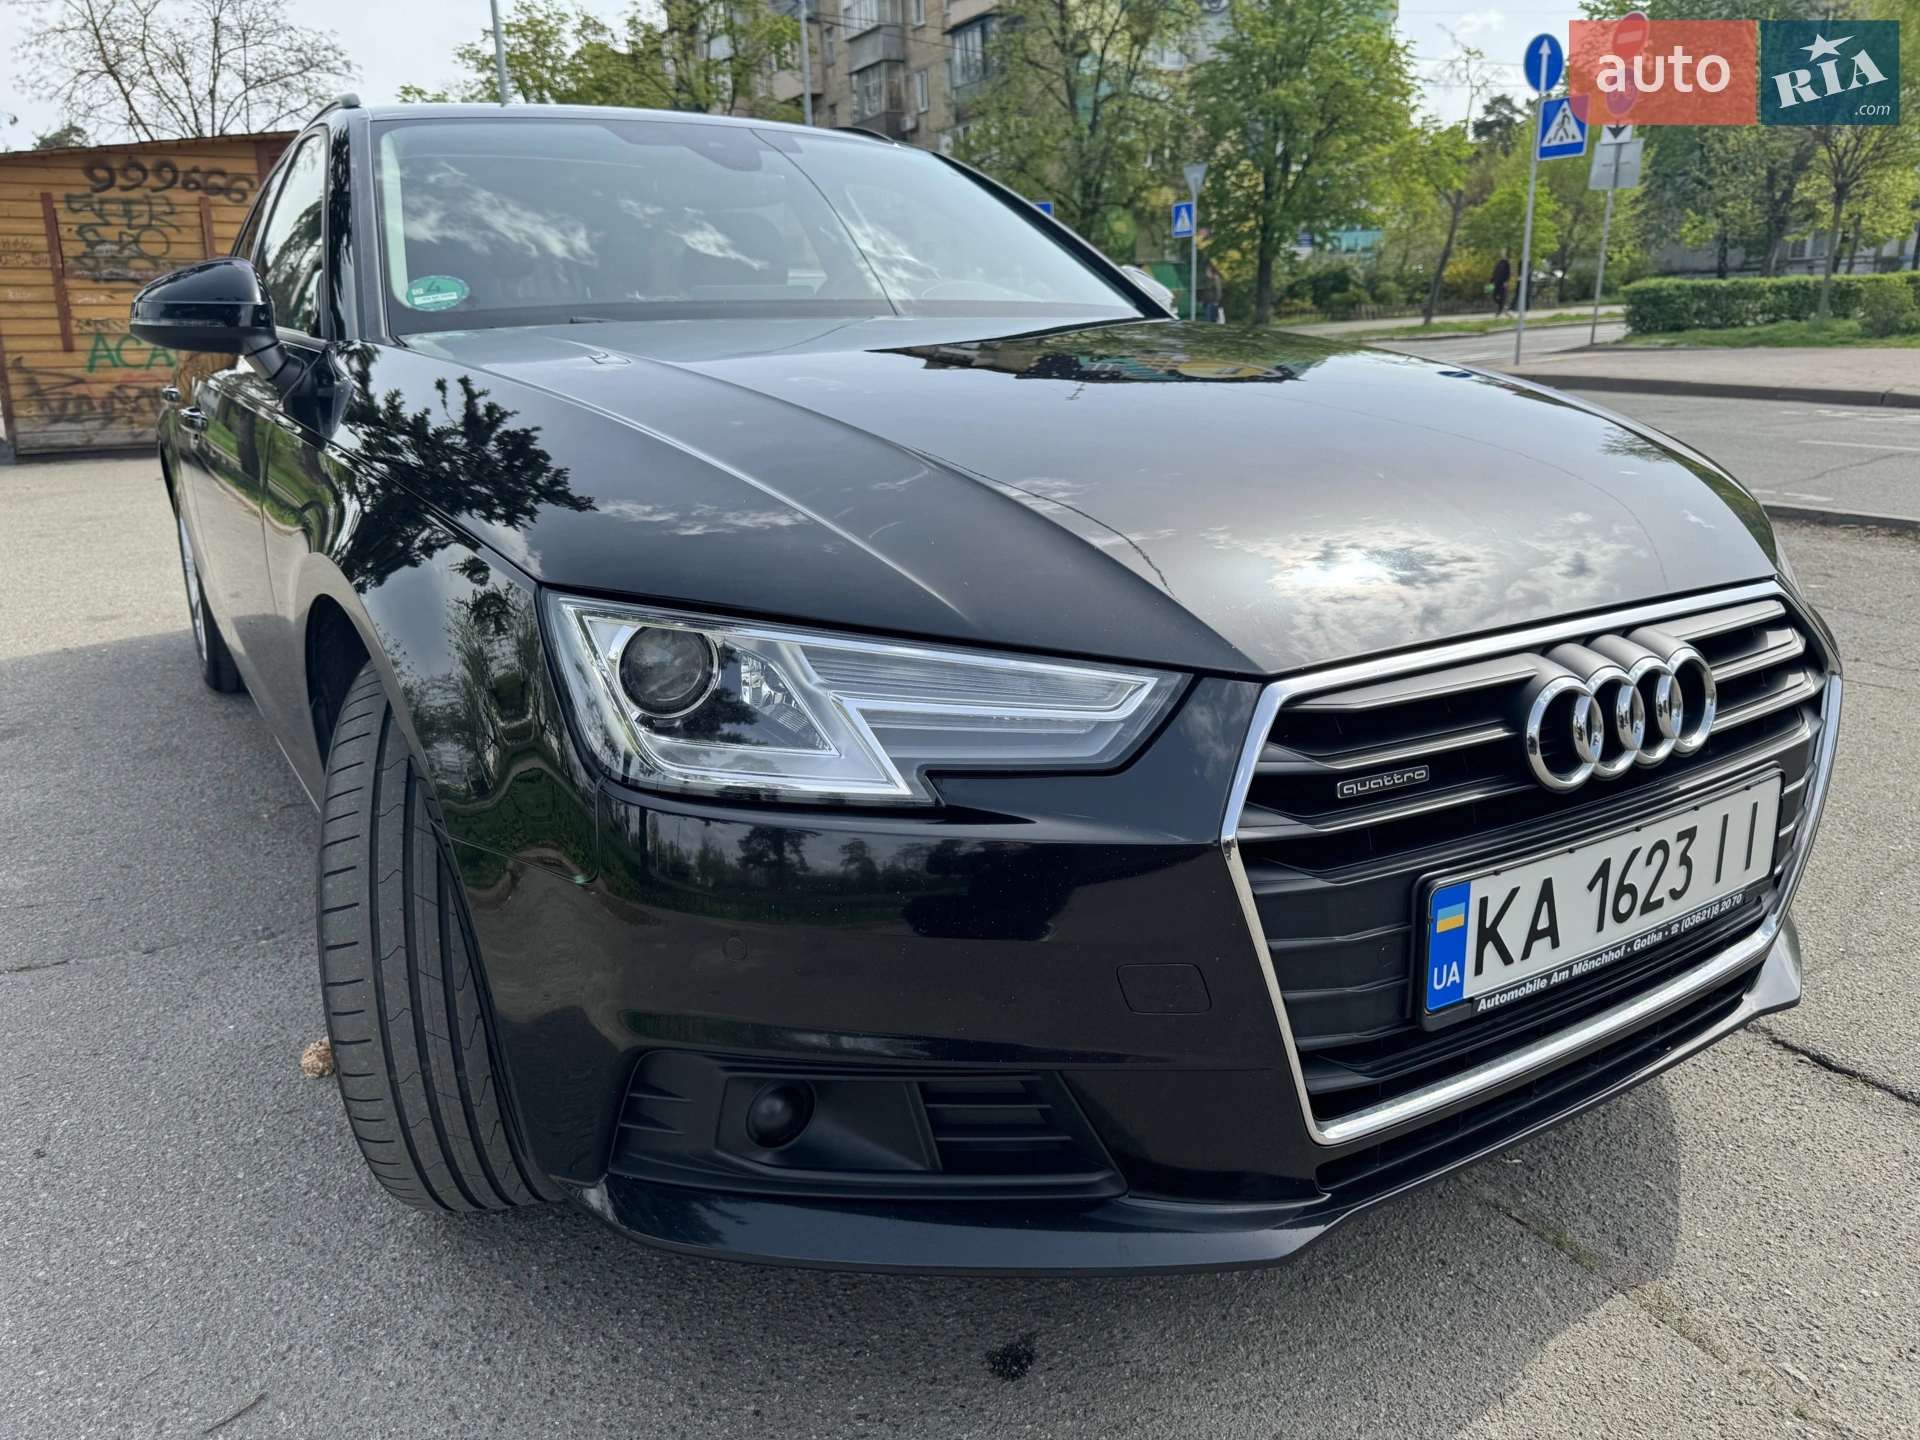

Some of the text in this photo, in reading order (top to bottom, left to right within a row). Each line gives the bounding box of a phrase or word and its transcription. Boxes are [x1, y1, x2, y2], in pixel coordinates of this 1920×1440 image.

[1343, 770, 1426, 794] quattro
[1474, 801, 1759, 977] KA 1623 II
[1433, 961, 1461, 990] UA
[1477, 978, 1548, 1013] Automobile
[1550, 969, 1570, 985] Am
[1572, 943, 1625, 979] Mönchhof
[1633, 931, 1663, 952] Gotha
